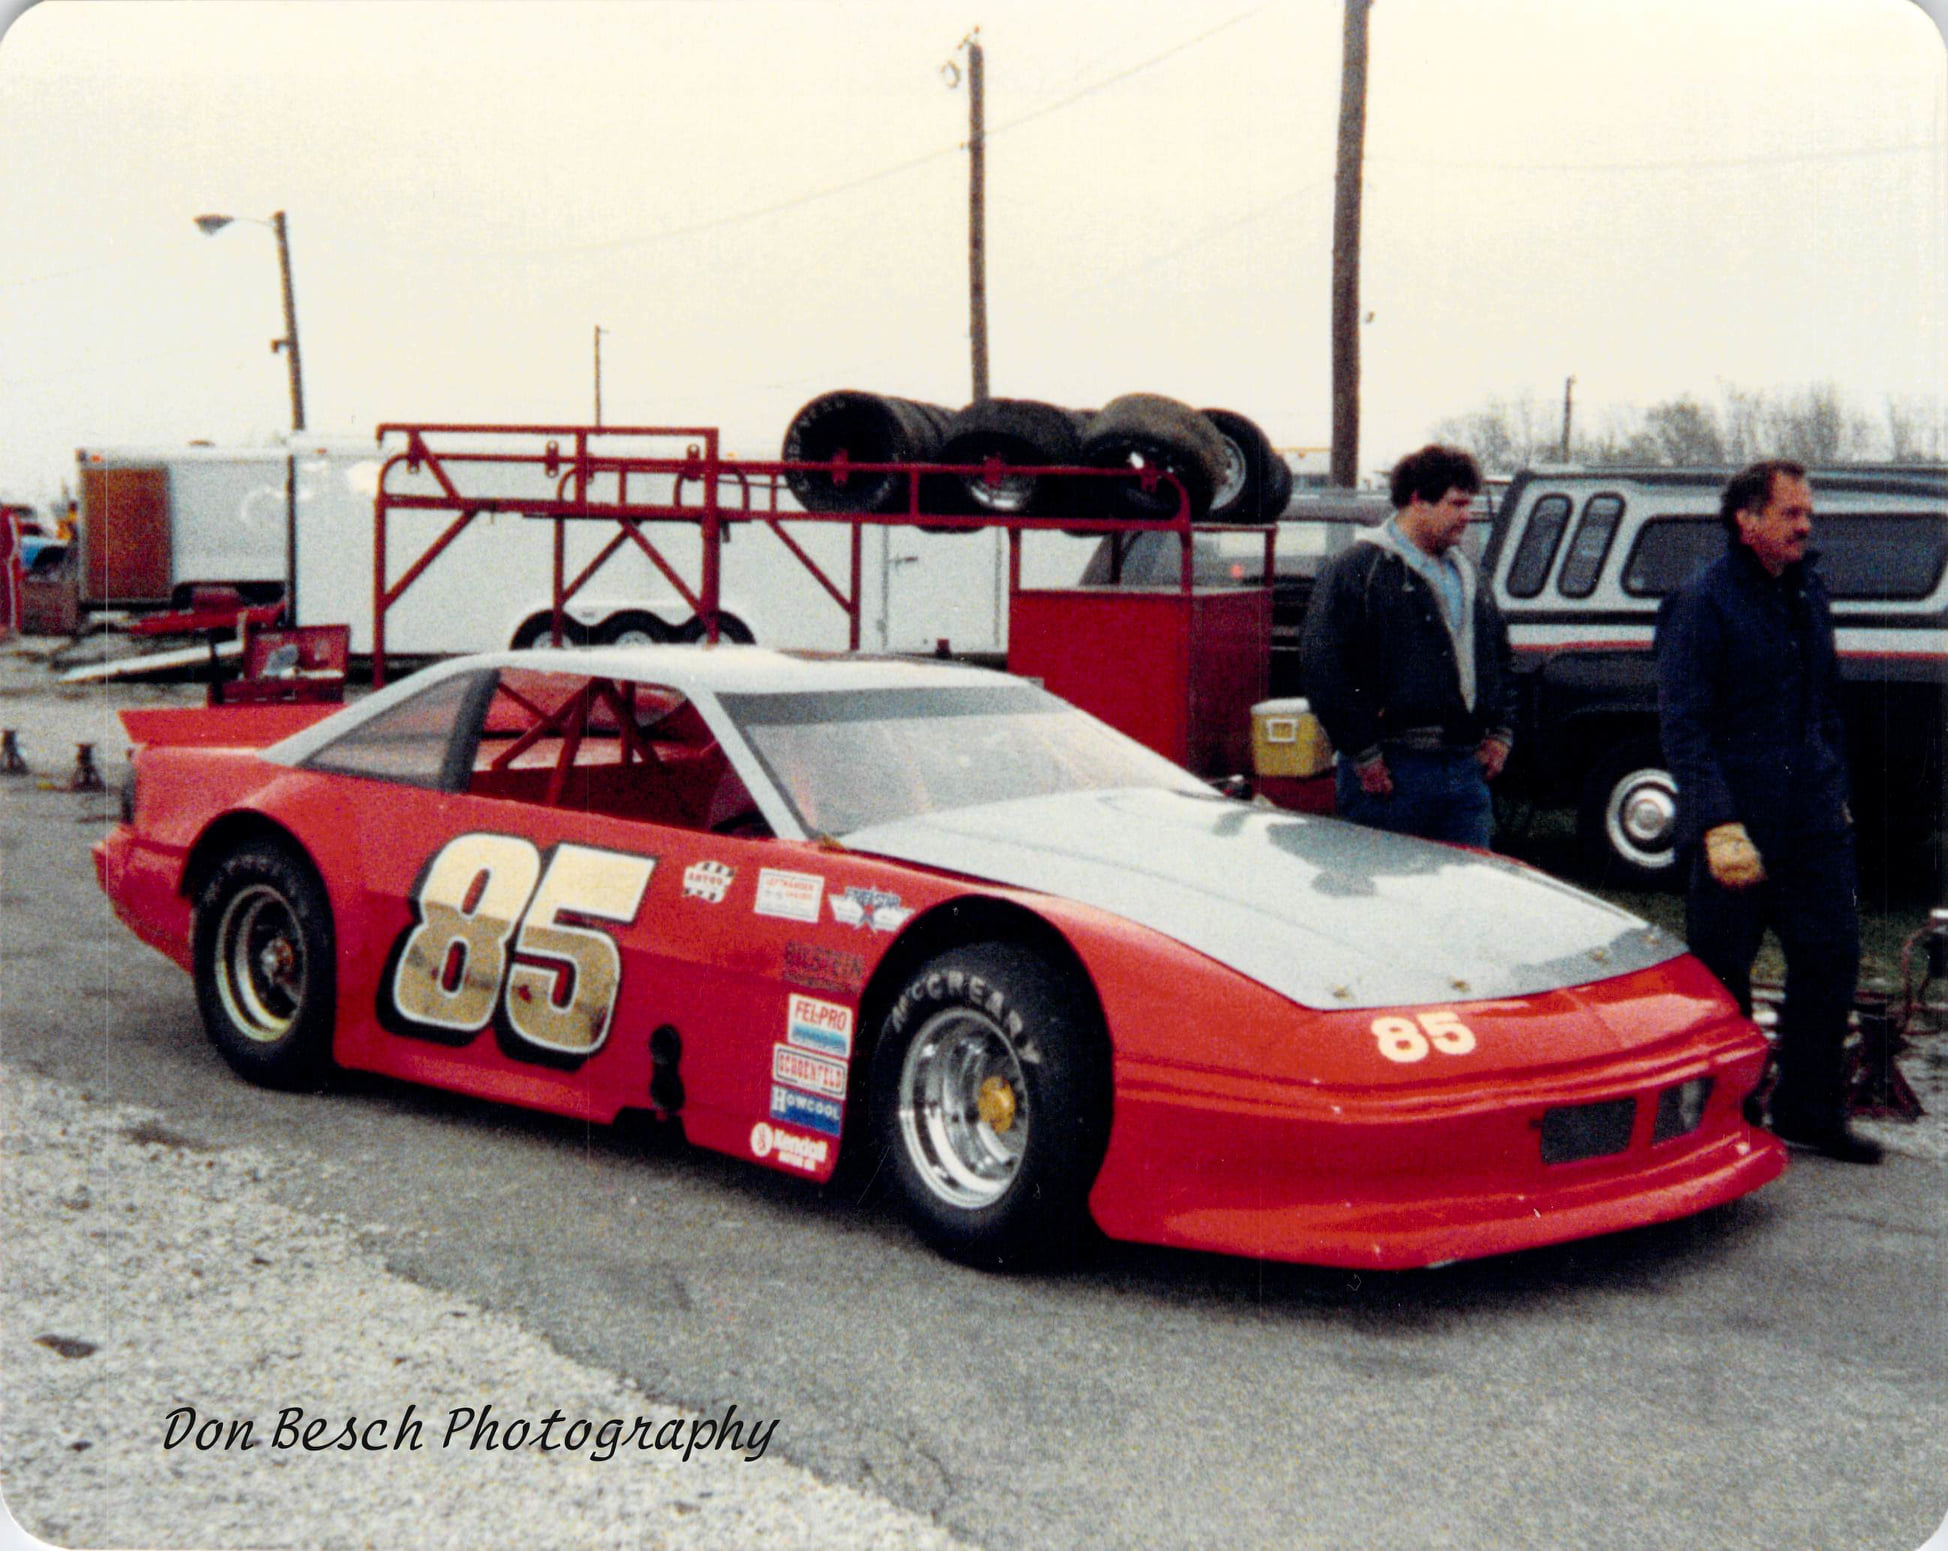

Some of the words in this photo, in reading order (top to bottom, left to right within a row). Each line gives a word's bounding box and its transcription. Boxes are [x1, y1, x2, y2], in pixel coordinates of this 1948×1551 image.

[389, 831, 657, 1060] 85
[1371, 1011, 1475, 1063] 85
[778, 1053, 842, 1089] SCHOENFELD
[774, 1129, 828, 1162] Kendall
